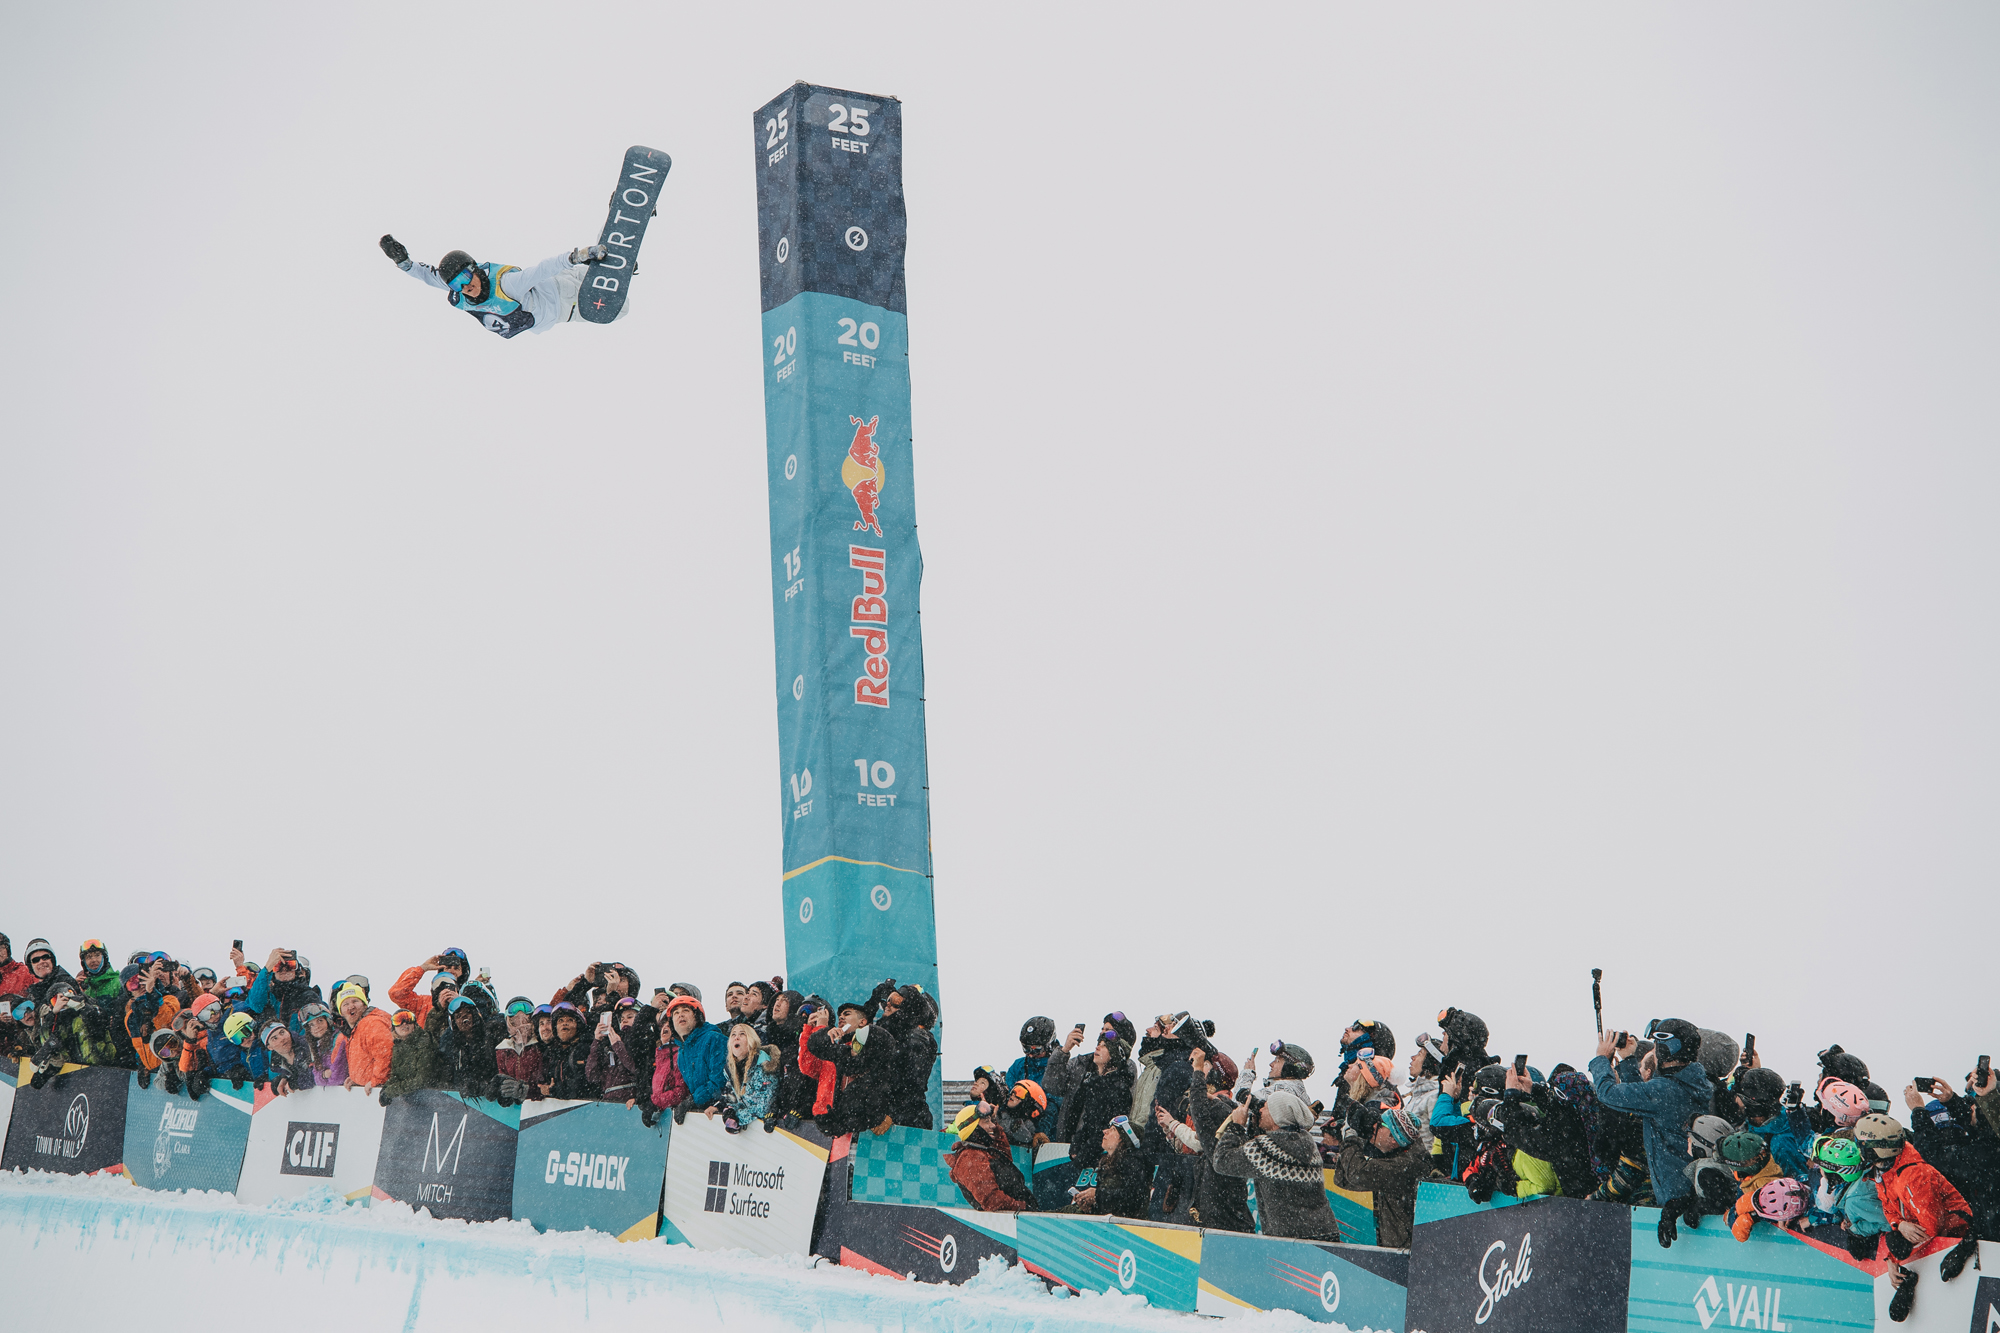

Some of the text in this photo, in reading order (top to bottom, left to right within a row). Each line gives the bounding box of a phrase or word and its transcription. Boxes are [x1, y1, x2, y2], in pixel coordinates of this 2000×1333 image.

[766, 108, 789, 149] 25
[828, 103, 870, 136] 25
[769, 142, 789, 167] FEET
[831, 137, 869, 154] FEET
[592, 163, 658, 292] BURTON
[774, 325, 797, 365] 20
[837, 317, 880, 349] 20
[777, 359, 796, 382] FEET
[843, 350, 877, 368] FEET
[783, 545, 802, 582] 15
[784, 578, 804, 602] FEET
[849, 544, 890, 708] Red Bull
[854, 759, 896, 789] 10
[857, 792, 897, 806] FEET
[35, 1135, 76, 1159] TOWN OF VAIL
[289, 1129, 335, 1169] CLIF
[421, 1111, 468, 1176] M
[544, 1150, 630, 1192] G-SHOCK
[733, 1162, 785, 1191] Microsoft
[416, 1182, 454, 1204] MITCH
[729, 1192, 771, 1219] Surface
[1475, 1232, 1534, 1325] Stoli
[1726, 1282, 1786, 1332] VAIL
